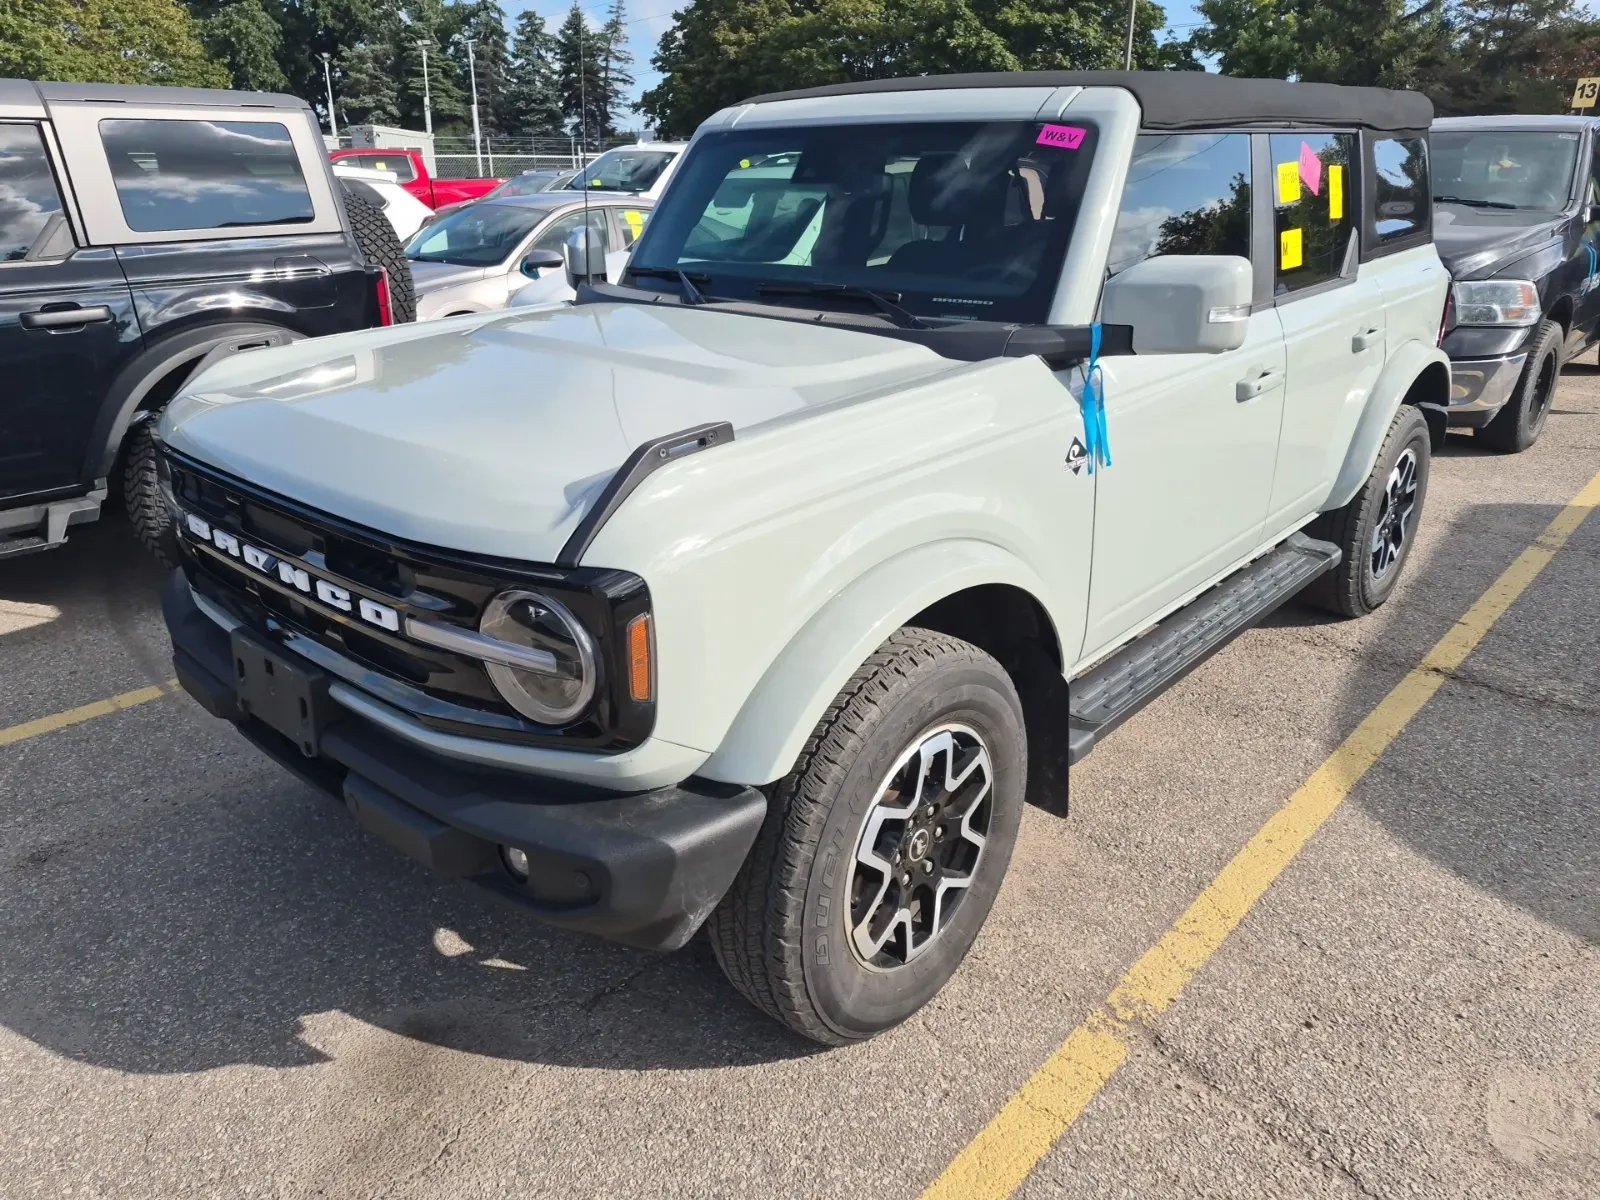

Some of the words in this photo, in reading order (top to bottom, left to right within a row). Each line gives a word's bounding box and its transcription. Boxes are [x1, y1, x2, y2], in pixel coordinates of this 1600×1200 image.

[1577, 83, 1597, 99] 13
[1045, 130, 1079, 143] W&V
[187, 514, 399, 631] BRONCO
